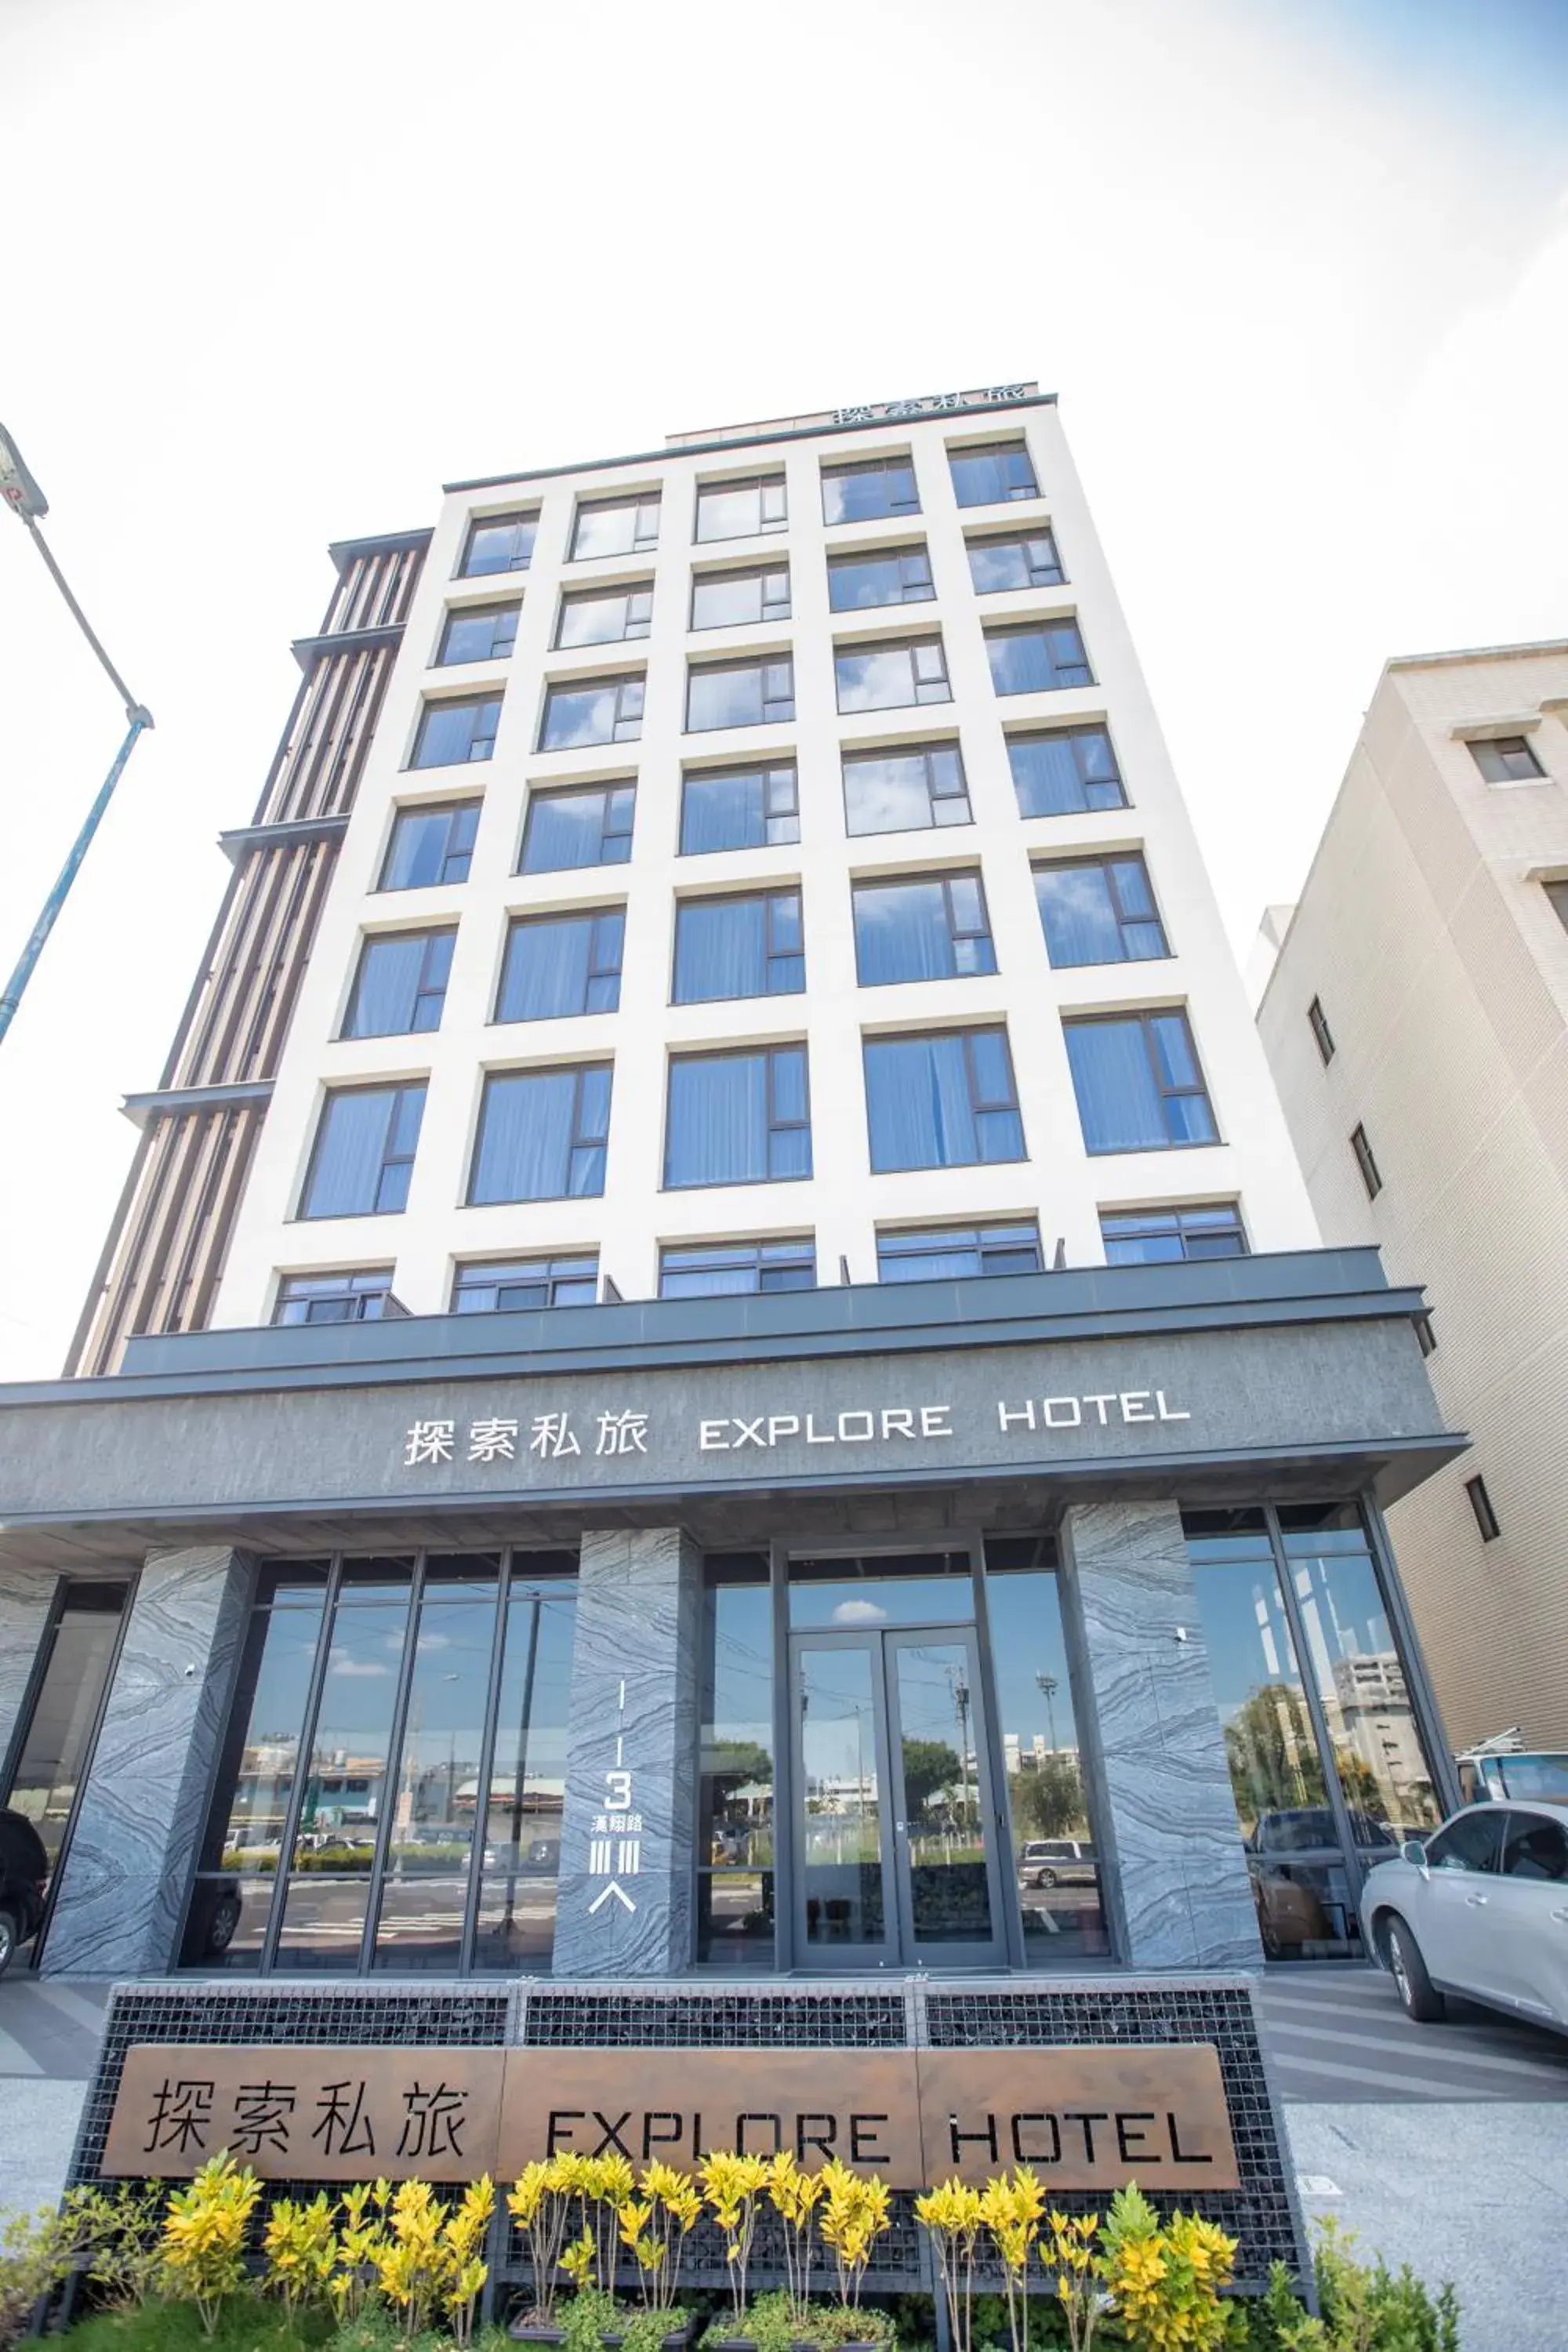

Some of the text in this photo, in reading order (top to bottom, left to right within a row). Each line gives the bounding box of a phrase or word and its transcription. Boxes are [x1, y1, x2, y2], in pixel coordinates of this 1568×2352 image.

[405, 1391, 1190, 1466] 探索私旅 EXPLORE HOTEL
[142, 2078, 1213, 2164] 探索私旅 EXPLORE HOTEL
